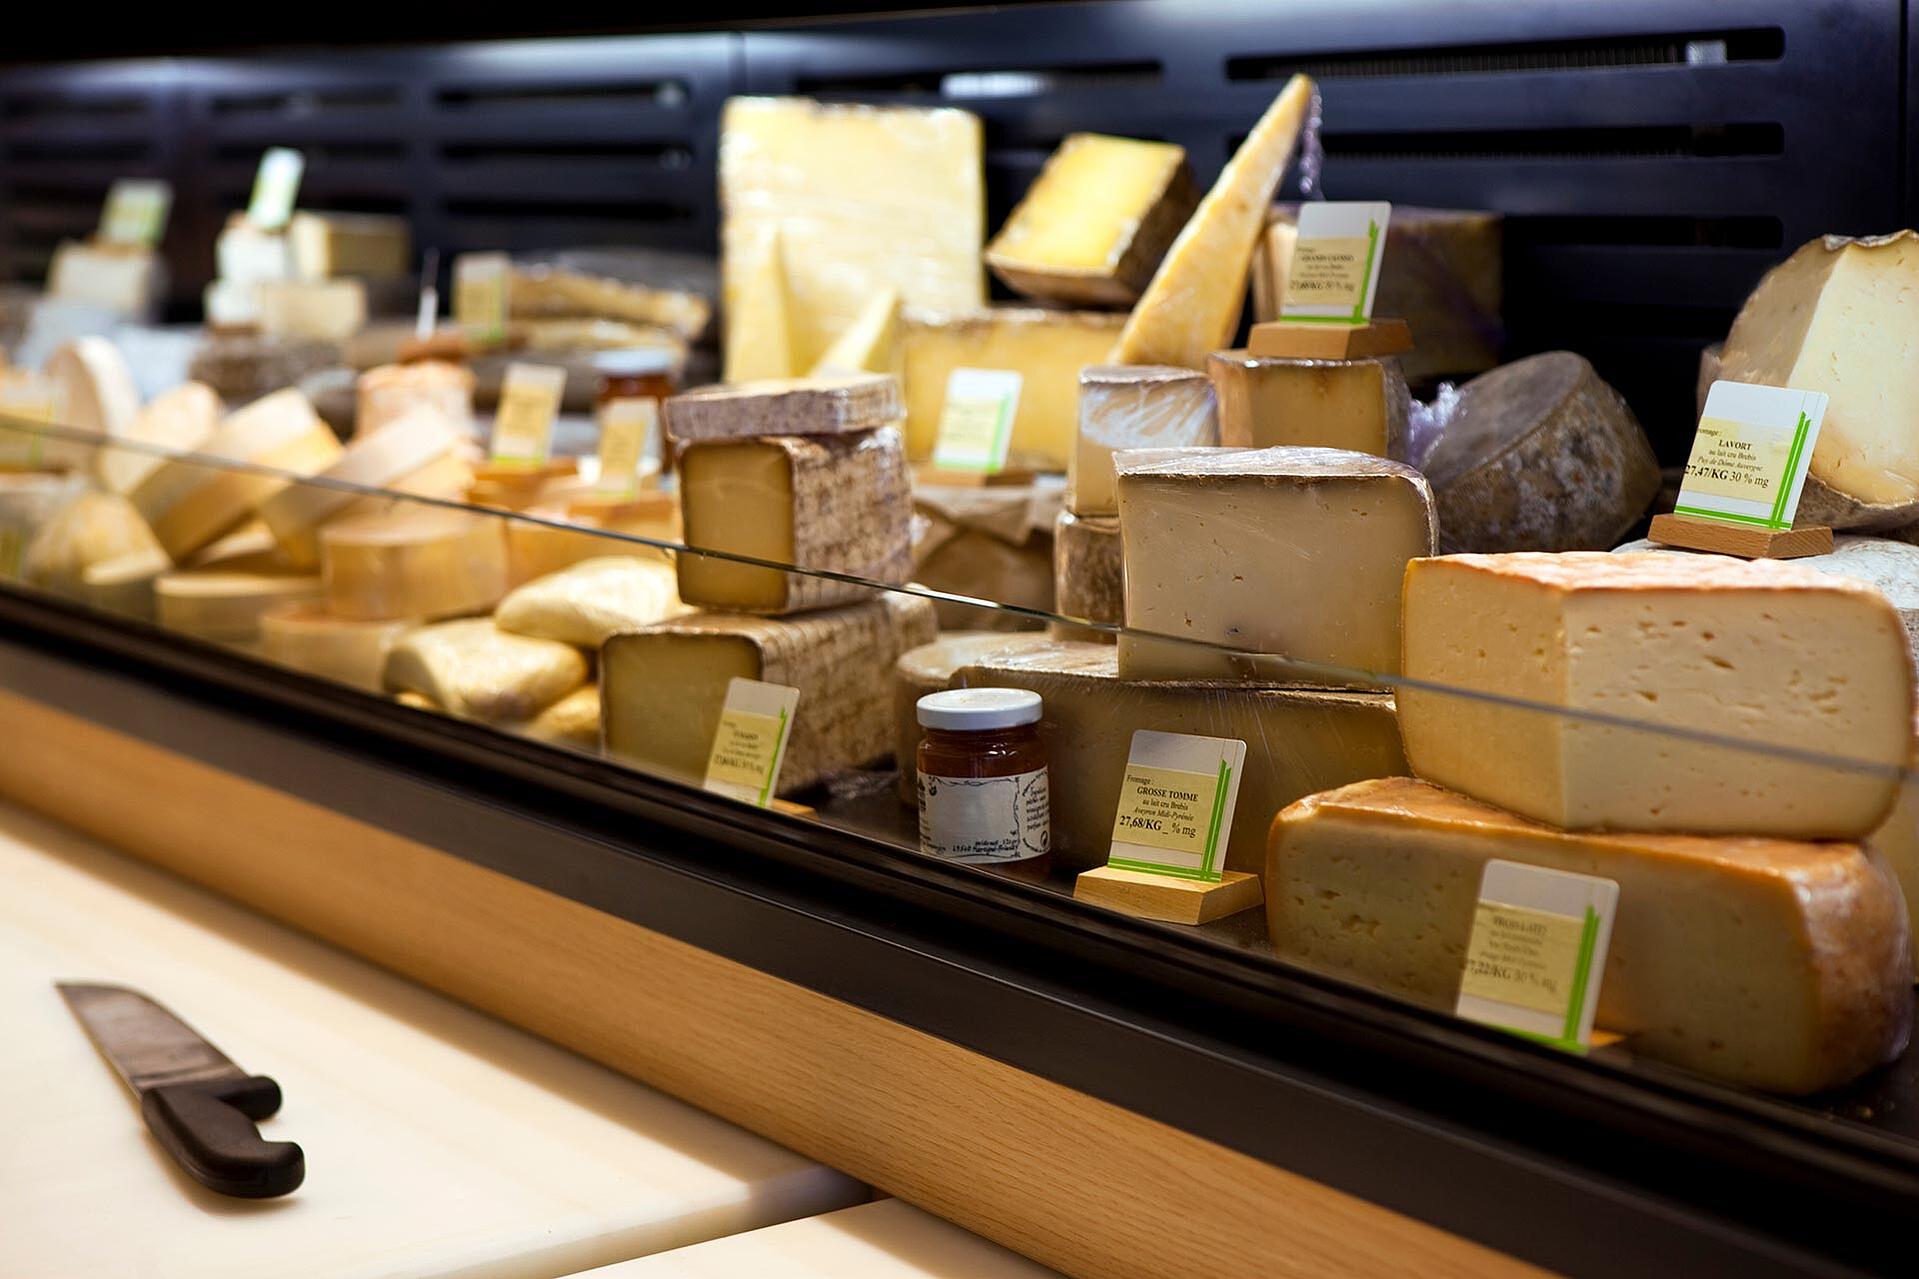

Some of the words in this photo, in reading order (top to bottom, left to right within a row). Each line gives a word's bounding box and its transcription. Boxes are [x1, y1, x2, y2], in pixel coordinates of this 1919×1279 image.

[1719, 439, 1753, 451] LAVORT
[1738, 451, 1756, 461] Brebis
[1729, 472, 1742, 482] 30
[1754, 477, 1769, 489] mg
[1126, 774, 1151, 785] Fromage
[1137, 786, 1168, 798] GROSSE
[1169, 790, 1199, 802] TOMME
[1170, 800, 1189, 811] Brebis
[1120, 815, 1162, 831] 27,68/KG
[1182, 826, 1196, 839] mg
